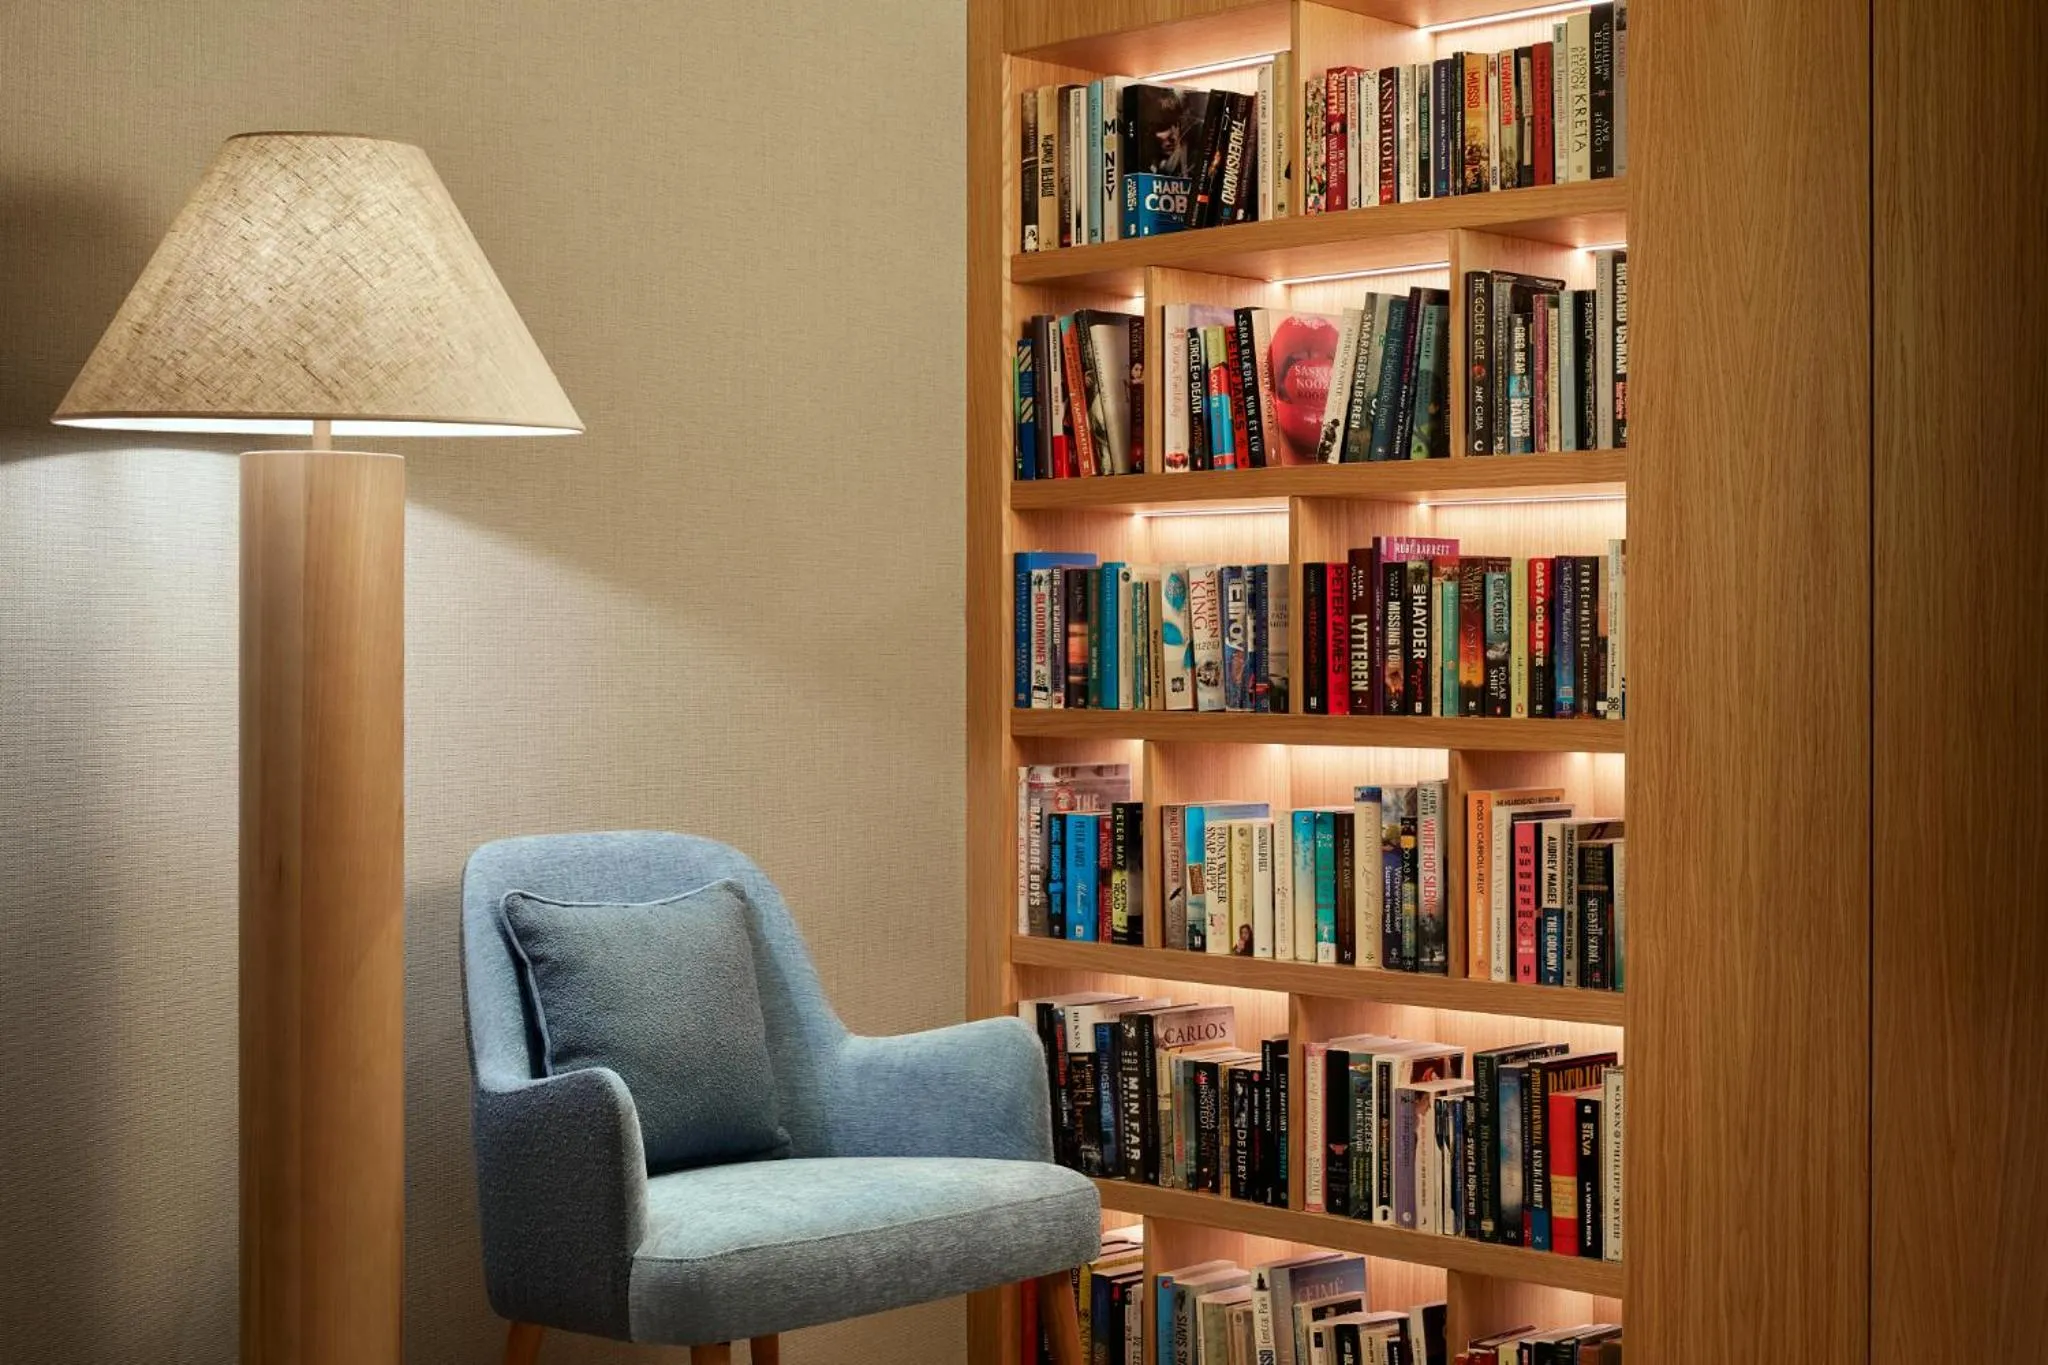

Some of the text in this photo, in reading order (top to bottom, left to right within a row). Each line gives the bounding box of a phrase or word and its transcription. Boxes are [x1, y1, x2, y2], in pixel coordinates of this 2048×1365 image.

[1328, 72, 1339, 115] SMITH
[1338, 72, 1346, 115] WILBUR
[1467, 71, 1481, 109] MUSSO
[1501, 55, 1514, 127] EDWARDSON
[1570, 47, 1579, 91] BEEVOR
[1578, 46, 1587, 91] ANTONY
[1381, 76, 1394, 177] ANNE HOLT
[1575, 94, 1588, 153] KRETA
[1594, 111, 1602, 153] LOUISE
[1221, 118, 1247, 206] FADERSMORD
[1238, 319, 1249, 348] SARA
[1474, 278, 1486, 360] THE GOLDEN GATE
[1584, 302, 1594, 343] FAMILY
[1616, 262, 1627, 375] RICHARD OSMAN
[1188, 337, 1202, 414] CIRCLE DEATH
[1514, 327, 1526, 375] GREG BEAR
[1209, 367, 1221, 408] Lovers
[1228, 331, 1247, 432] PETER JAMES
[1246, 395, 1256, 417] KUN
[1475, 385, 1485, 431] AMY CHUA
[1510, 399, 1523, 438] RADIO
[1077, 424, 1088, 457] MARTEL
[1250, 435, 1260, 453] LIV
[1190, 579, 1208, 631] KING
[1205, 569, 1220, 640] STEPHEN
[1412, 584, 1427, 595] MO
[1534, 561, 1545, 667] CAST A COLD EYE
[1580, 564, 1591, 649] FORCE NATURE
[1034, 592, 1048, 669] BLOODMONEY
[1331, 565, 1345, 675] PETER JAMES
[1386, 601, 1402, 669] MISSING YOU
[1411, 595, 1428, 660] HAYDER
[1492, 601, 1506, 635] CUSSLER
[1350, 614, 1369, 692] LYTTEREN
[1489, 668, 1499, 698] SHIFT
[1498, 666, 1507, 700] POLAR
[1421, 788, 1430, 815] PORTER
[1429, 789, 1438, 814] HENRY
[1476, 799, 1485, 822] ROSS
[1029, 806, 1041, 907] BALTIMORE BOYS
[1051, 817, 1062, 881] JACK HIGGINS
[1115, 807, 1124, 867] PETER MAY
[1205, 826, 1217, 894] SNAP HAPPY
[1422, 818, 1437, 875] WHITE HOT
[1170, 849, 1180, 884] FEATHER
[1216, 826, 1227, 905] FIONA WALKER
[1343, 838, 1351, 890] END OF DAYS
[1546, 836, 1558, 905] AUDREY MAGEE
[1112, 882, 1121, 911] ROAD
[1120, 878, 1128, 913] COFFIN
[1384, 865, 1393, 934] Suzanne Heywood
[1394, 867, 1403, 933] Wavewalker
[1566, 878, 1574, 906] PAPERS
[1546, 916, 1558, 972] THE COLONY
[1163, 1022, 1227, 1046] CARLOS
[1086, 1063, 1097, 1100] Camilla
[1199, 1069, 1209, 1131] AHRNSTEDT
[1477, 1059, 1490, 1100] Timothy
[1531, 1067, 1542, 1104] PATRICIA
[1127, 1076, 1141, 1161] MIN FAR
[1206, 1088, 1217, 1131] SIMONA
[1363, 1098, 1374, 1154] VLIEGERS
[1236, 1129, 1249, 1181] DE JURY
[1582, 1122, 1592, 1157] SILVA
[1466, 1137, 1478, 1216] svarta löparen
[1585, 1181, 1592, 1193] LA
